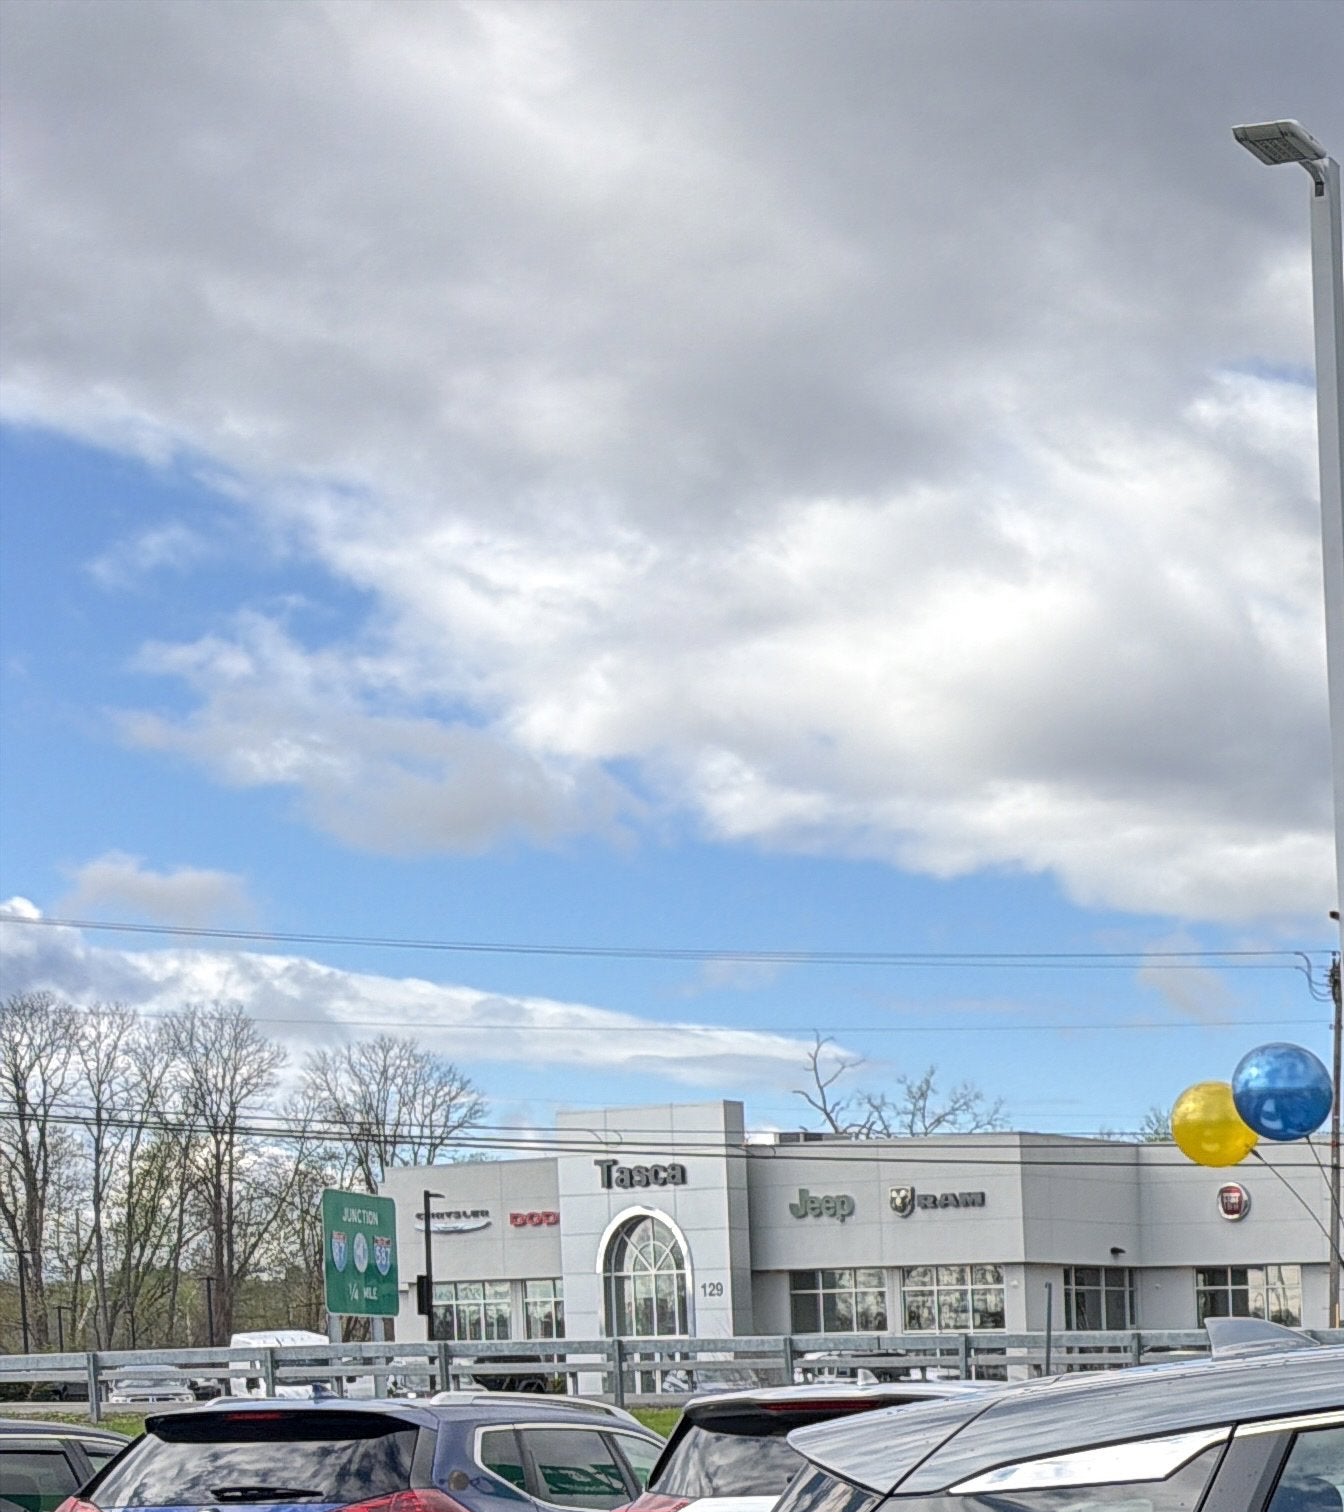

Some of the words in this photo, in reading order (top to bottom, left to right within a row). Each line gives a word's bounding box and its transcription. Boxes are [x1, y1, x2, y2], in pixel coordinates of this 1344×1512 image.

[594, 1159, 687, 1189] Tasca
[789, 1188, 855, 1223] Jeep
[917, 1191, 986, 1210] RAM
[342, 1207, 379, 1226] JUNCTION
[363, 1286, 378, 1301] MILE
[700, 1281, 724, 1298] 129
